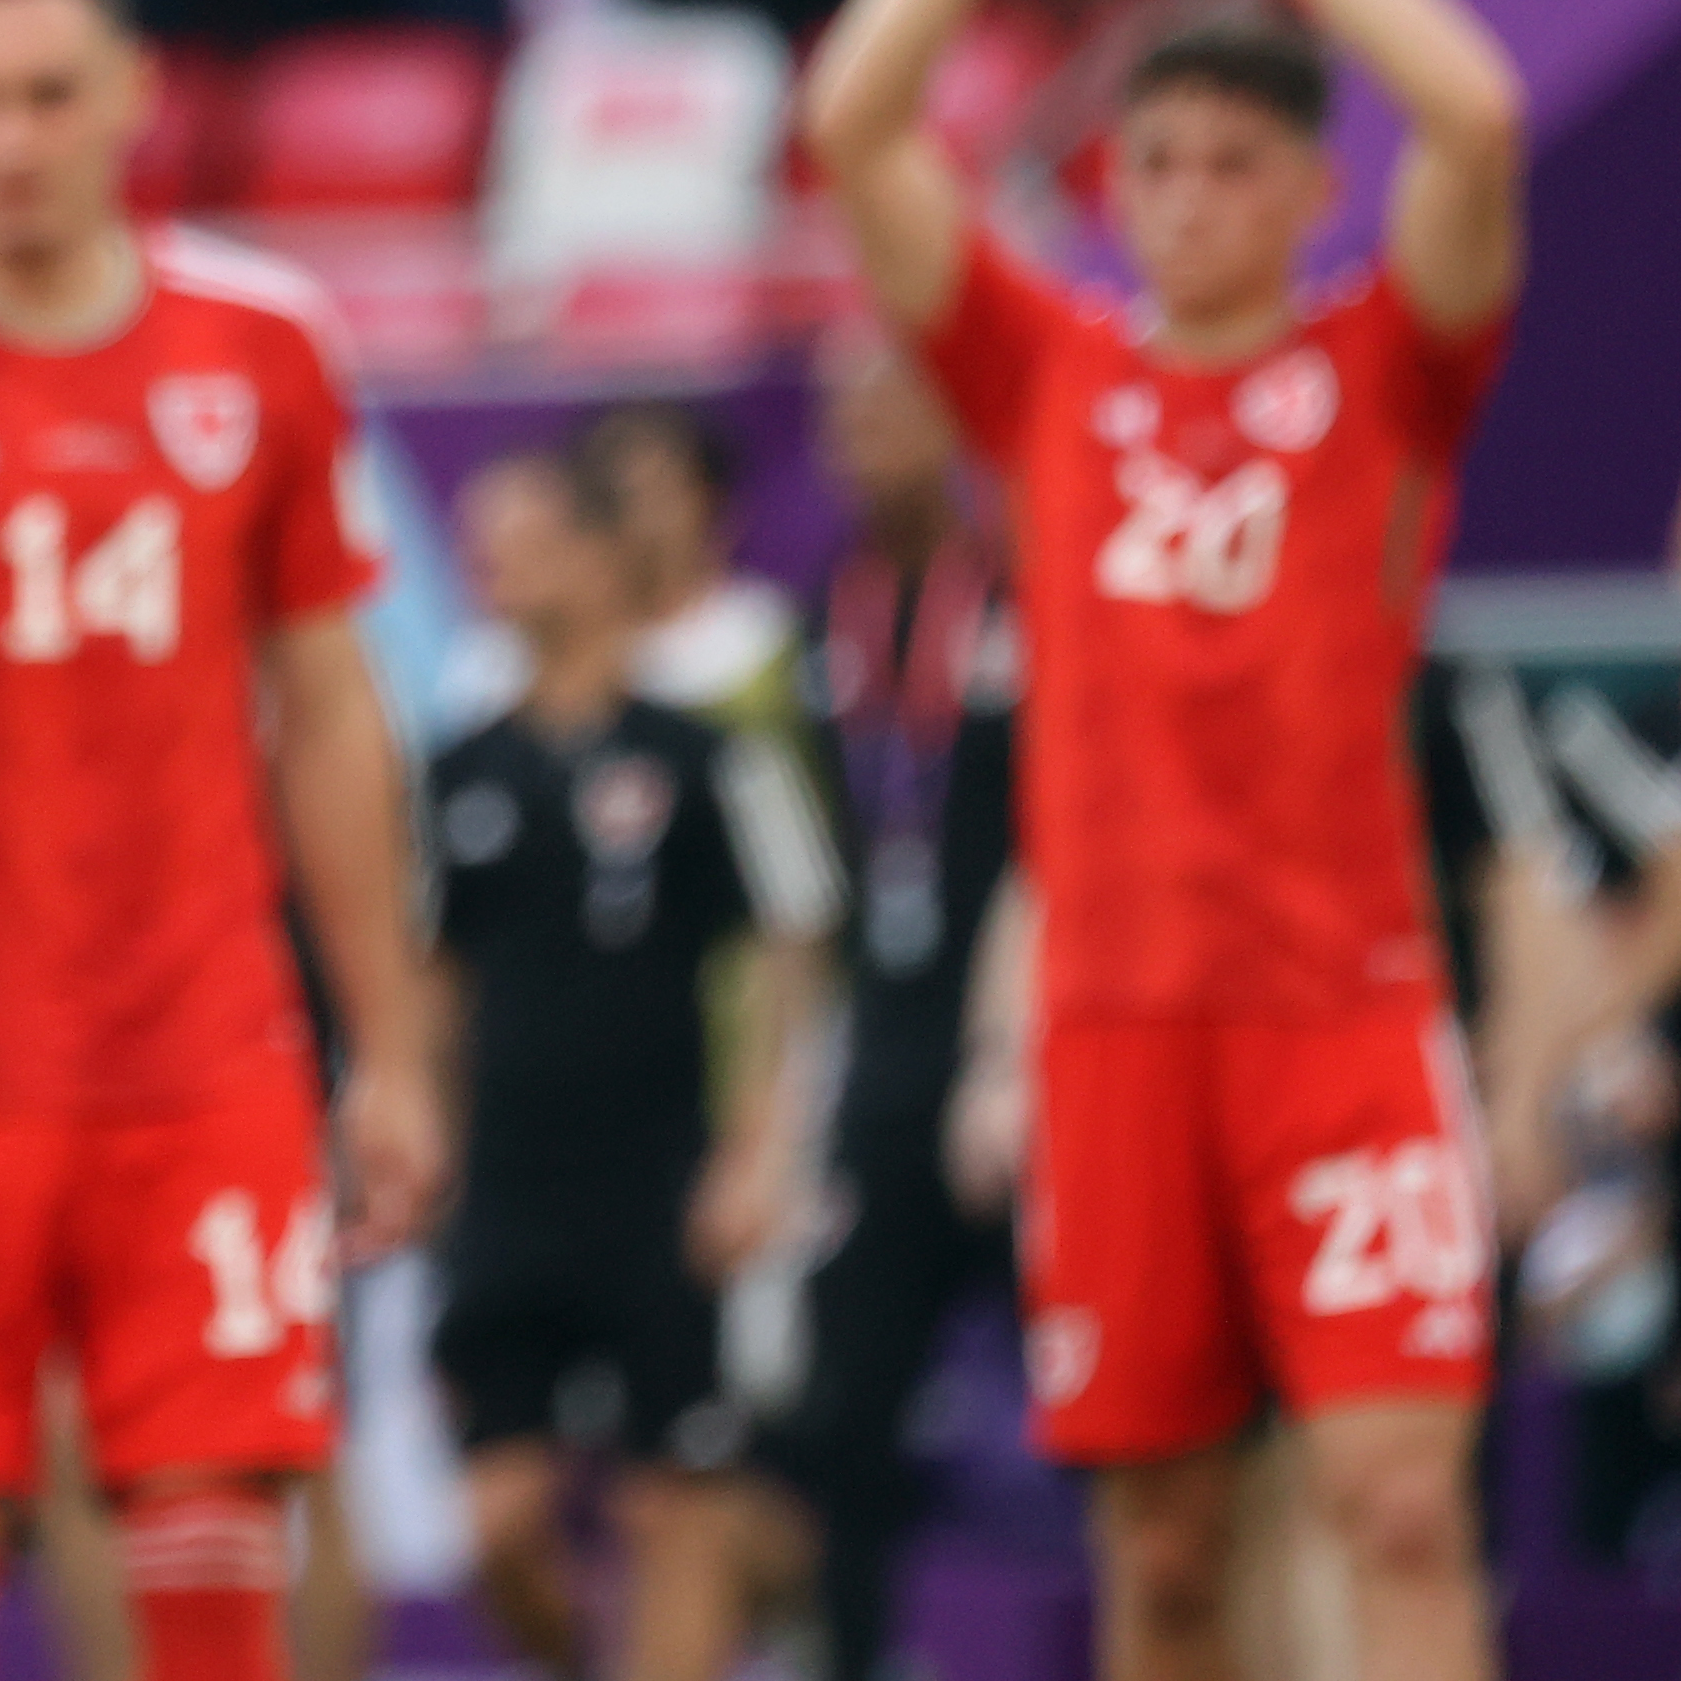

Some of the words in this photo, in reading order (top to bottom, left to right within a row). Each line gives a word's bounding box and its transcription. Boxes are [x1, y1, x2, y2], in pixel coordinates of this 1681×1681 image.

[0, 494, 179, 664] 14
[1092, 455, 1289, 614] 20
[1289, 1138, 1492, 1315] 20
